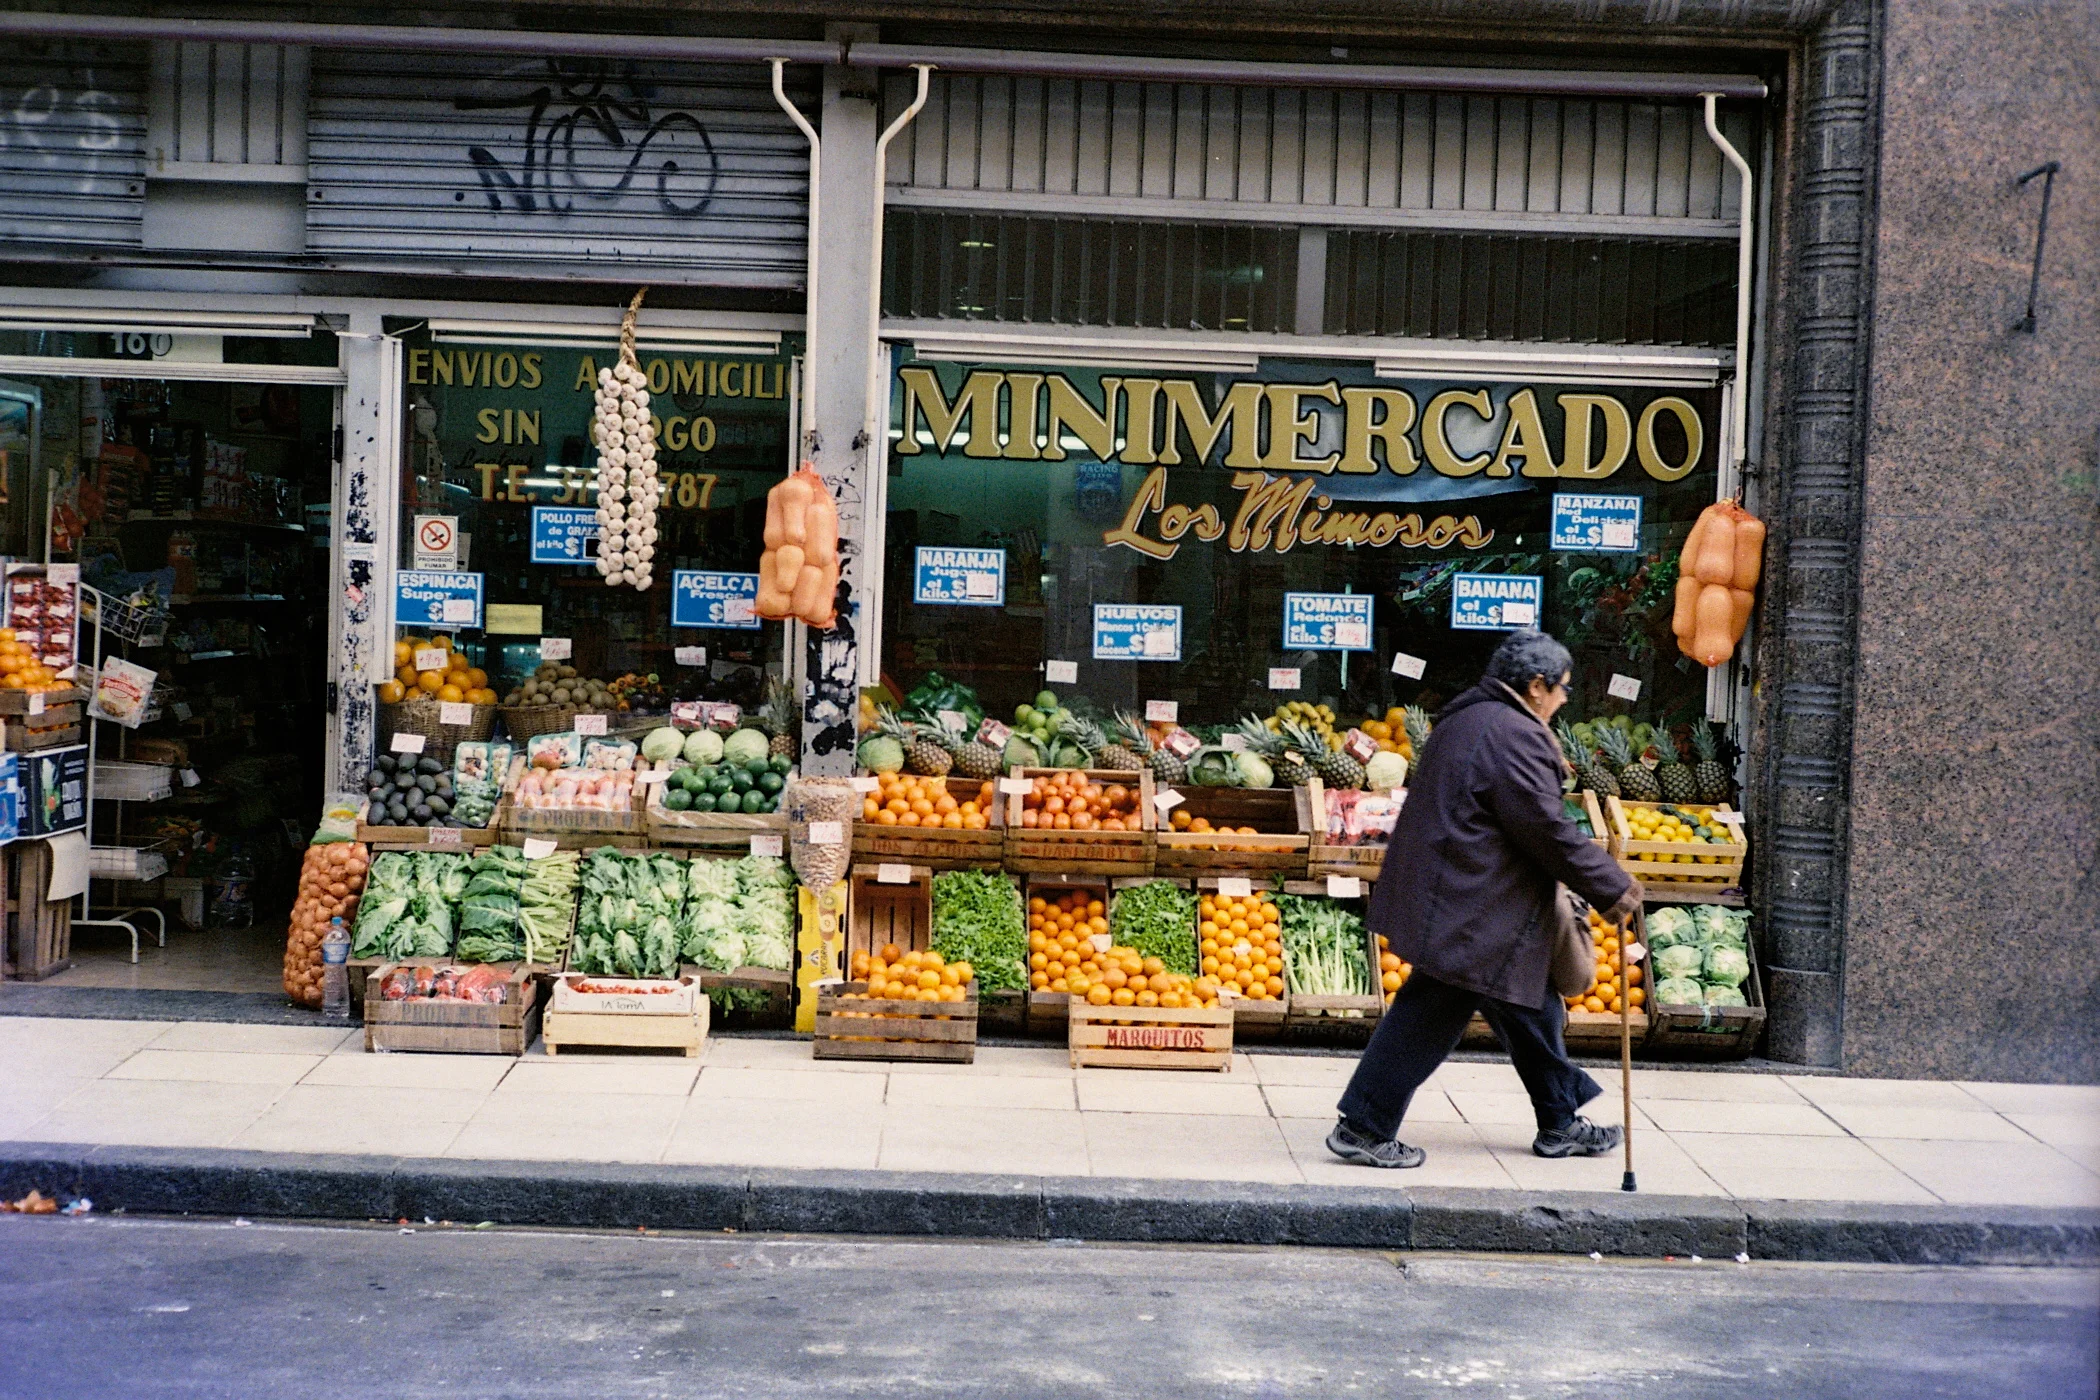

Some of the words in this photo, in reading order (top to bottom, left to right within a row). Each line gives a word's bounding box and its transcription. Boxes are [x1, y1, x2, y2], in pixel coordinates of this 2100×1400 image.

[408, 349, 543, 389] ENVIOS
[574, 355, 599, 392] A
[634, 357, 792, 399] OMICILI
[475, 408, 541, 446] SIN
[896, 366, 1704, 482] MINIMERCADO
[474, 463, 538, 503] T.E.
[1558, 497, 1637, 510] MANZANA
[540, 512, 573, 524] POLLO
[1102, 466, 1225, 560] Los
[1228, 471, 1496, 555] Mimosos
[1556, 507, 1582, 516] Red
[548, 526, 563, 536] de
[1564, 525, 1580, 534] el
[536, 540, 546, 549] el
[547, 539, 564, 549] kilo
[1556, 534, 1587, 545] kilo
[920, 550, 1000, 569] NARANJA
[399, 573, 478, 589] ESPINACA
[926, 579, 942, 589] el
[401, 587, 452, 601] Super
[921, 588, 950, 599] kilo
[1458, 580, 1536, 599] BANANA
[1290, 597, 1367, 613] TOMATE
[1461, 600, 1480, 611] el
[1098, 608, 1177, 620] HUEVOS
[1456, 611, 1488, 625] kilo
[1290, 623, 1307, 633] el
[1290, 632, 1318, 643] kilo
[1107, 1028, 1205, 1047] MARQUITOS
